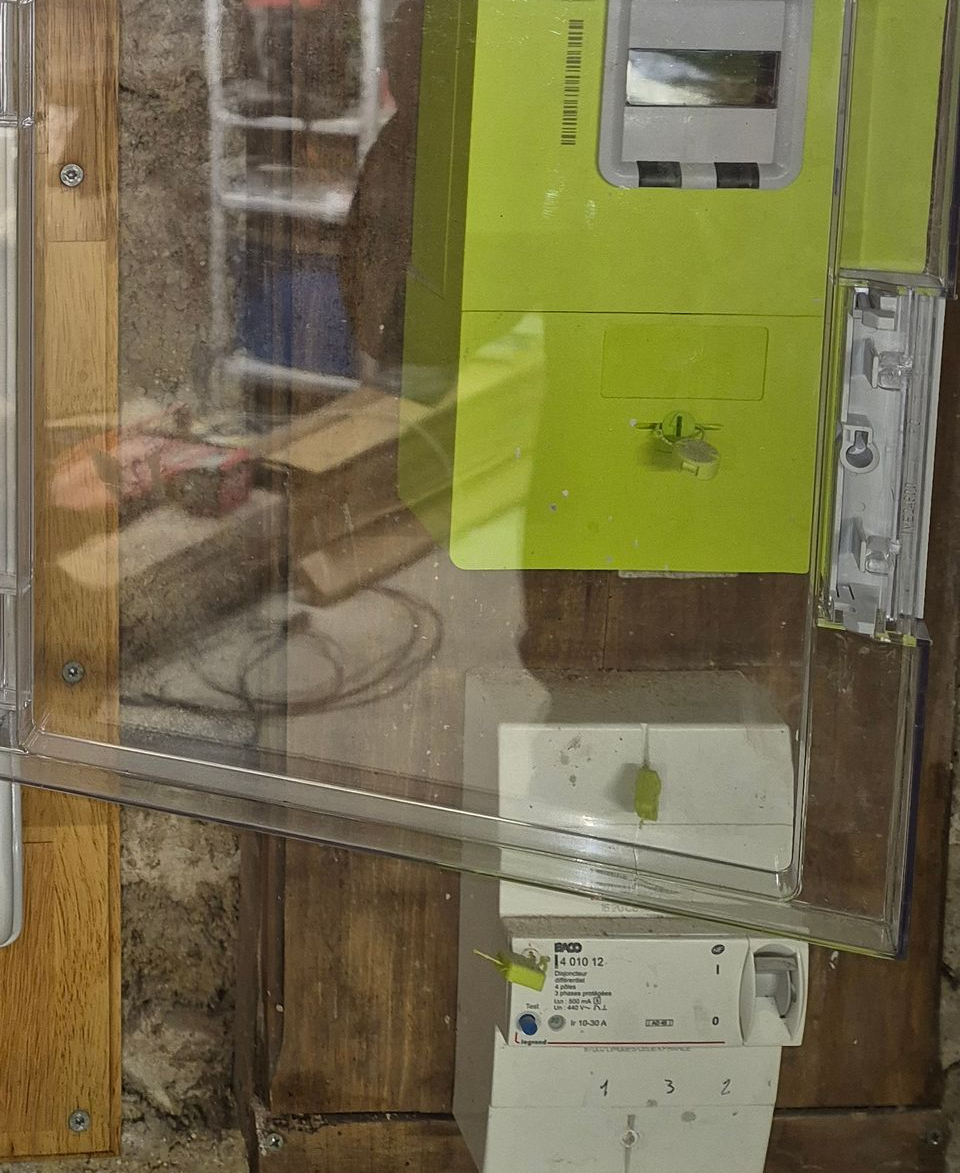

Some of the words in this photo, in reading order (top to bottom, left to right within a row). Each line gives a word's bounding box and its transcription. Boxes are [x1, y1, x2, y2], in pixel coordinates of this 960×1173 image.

[569, 957, 589, 967] 010
[592, 957, 604, 967] 12
[578, 1019, 600, 1027] 10-30
[601, 1019, 607, 1027] A
[600, 1079, 609, 1096] 1
[664, 1079, 675, 1094] 3
[720, 1078, 731, 1095] 2
